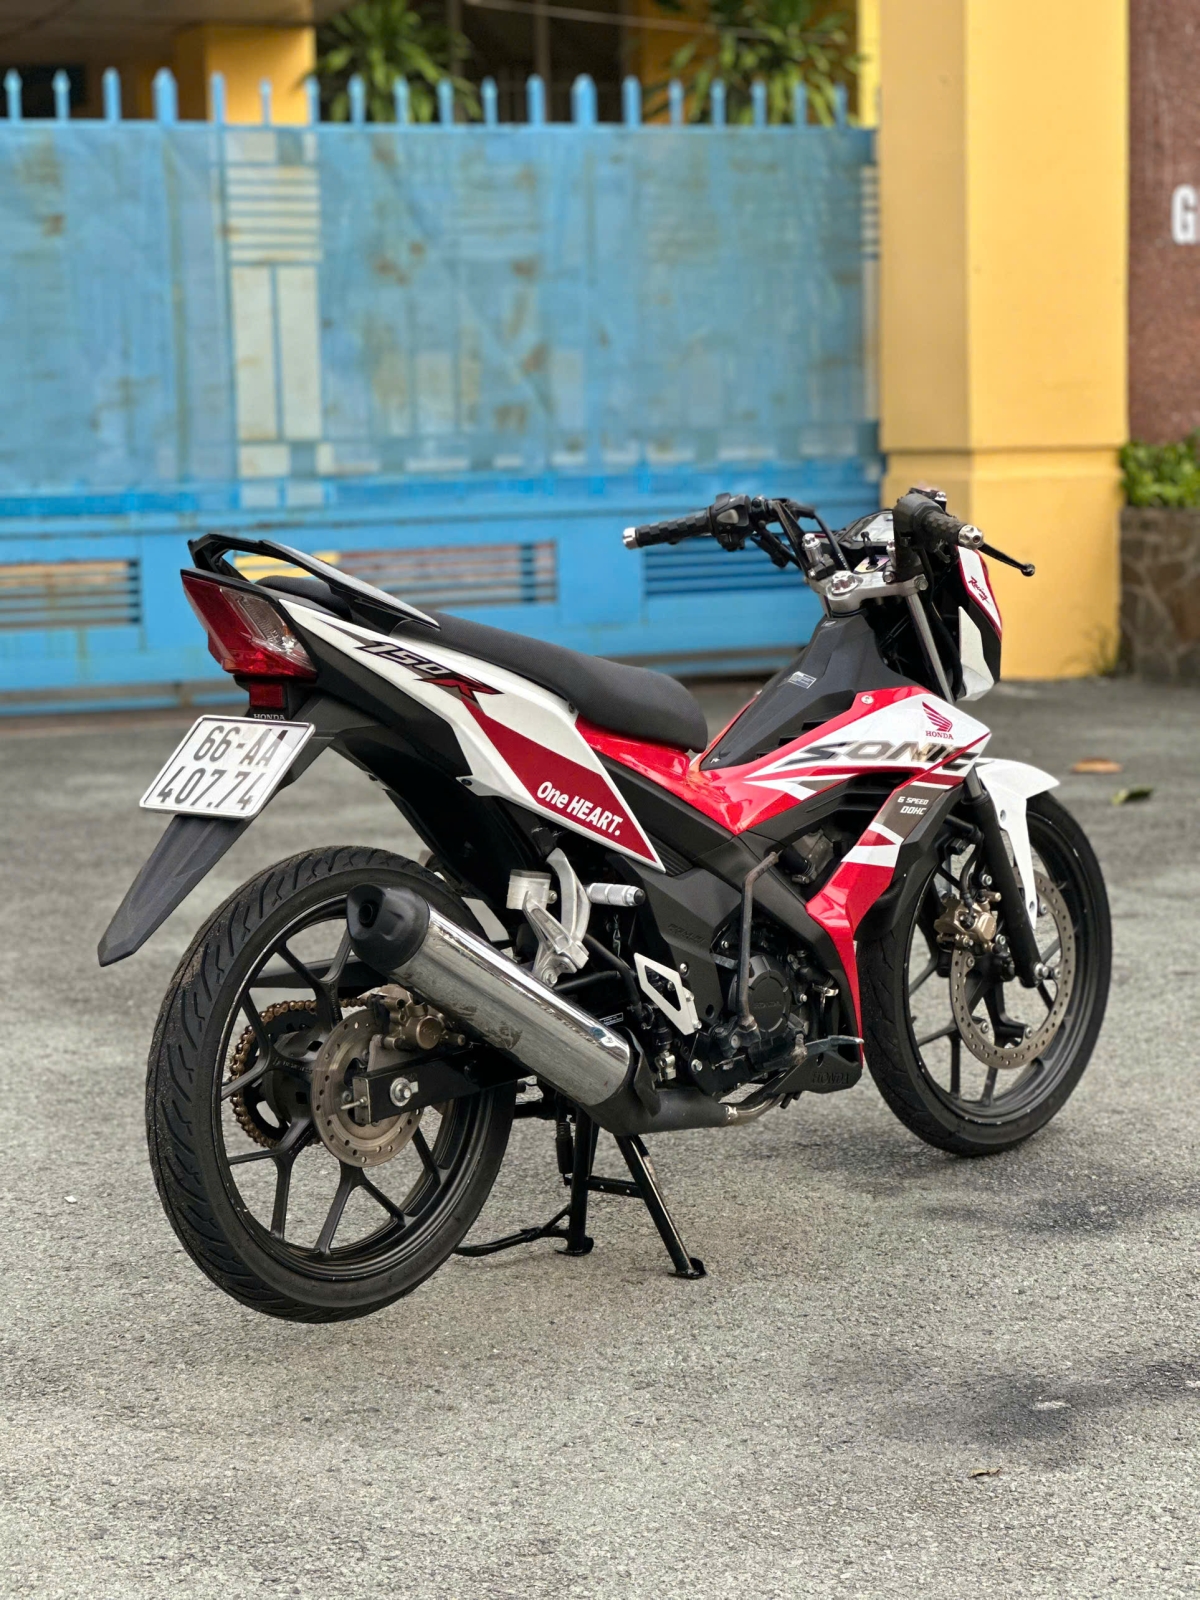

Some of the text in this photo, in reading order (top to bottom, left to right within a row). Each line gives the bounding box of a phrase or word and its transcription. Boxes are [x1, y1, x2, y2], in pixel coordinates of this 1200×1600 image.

[253, 713, 286, 721] HONDA
[925, 730, 954, 740] HONDA
[193, 725, 289, 767] 66-AA
[774, 739, 981, 772] SONIC
[156, 766, 266, 811] 407.74
[537, 781, 624, 836] One HEART.
[899, 805, 927, 815] DOHC
[905, 797, 929, 805] SPEED
